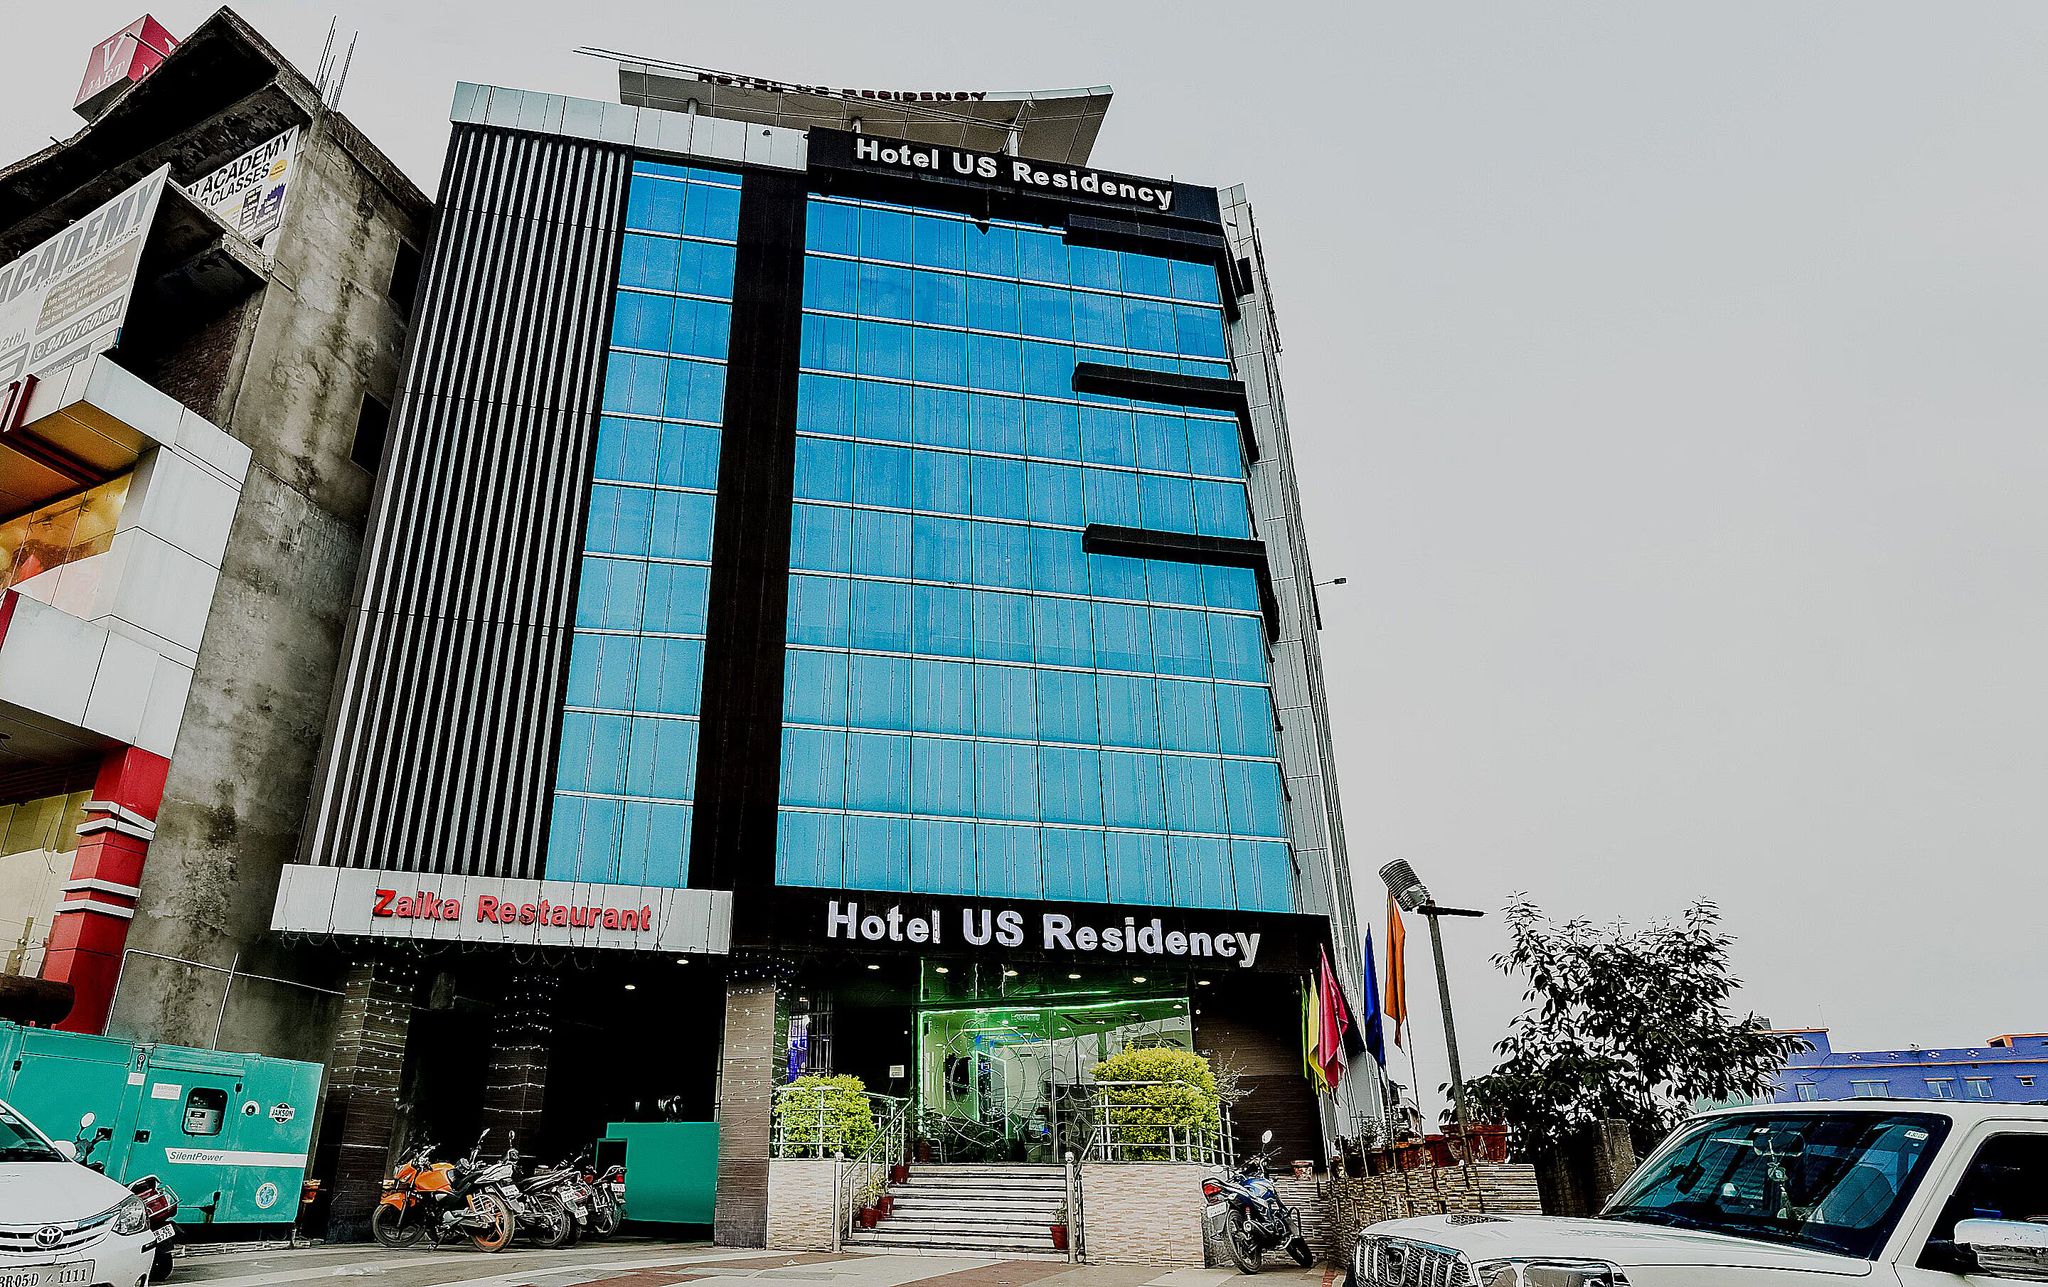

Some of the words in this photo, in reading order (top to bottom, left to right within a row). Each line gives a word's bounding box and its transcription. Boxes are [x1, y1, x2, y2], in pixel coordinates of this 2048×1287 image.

[842, 88, 987, 101] RESIDENCY
[200, 129, 294, 197] ACADEMY
[856, 138, 938, 170] Hotel
[952, 151, 997, 178] US
[1012, 161, 1173, 210] Residency
[210, 163, 270, 207] CLASSES
[373, 889, 461, 920] Zaika
[477, 894, 652, 931] Restaurant
[827, 901, 941, 944] Hotel
[962, 908, 1024, 947] US
[1043, 913, 1260, 968] Residency
[169, 1151, 224, 1162] SilentPower
[58, 1268, 86, 1284] 1111
